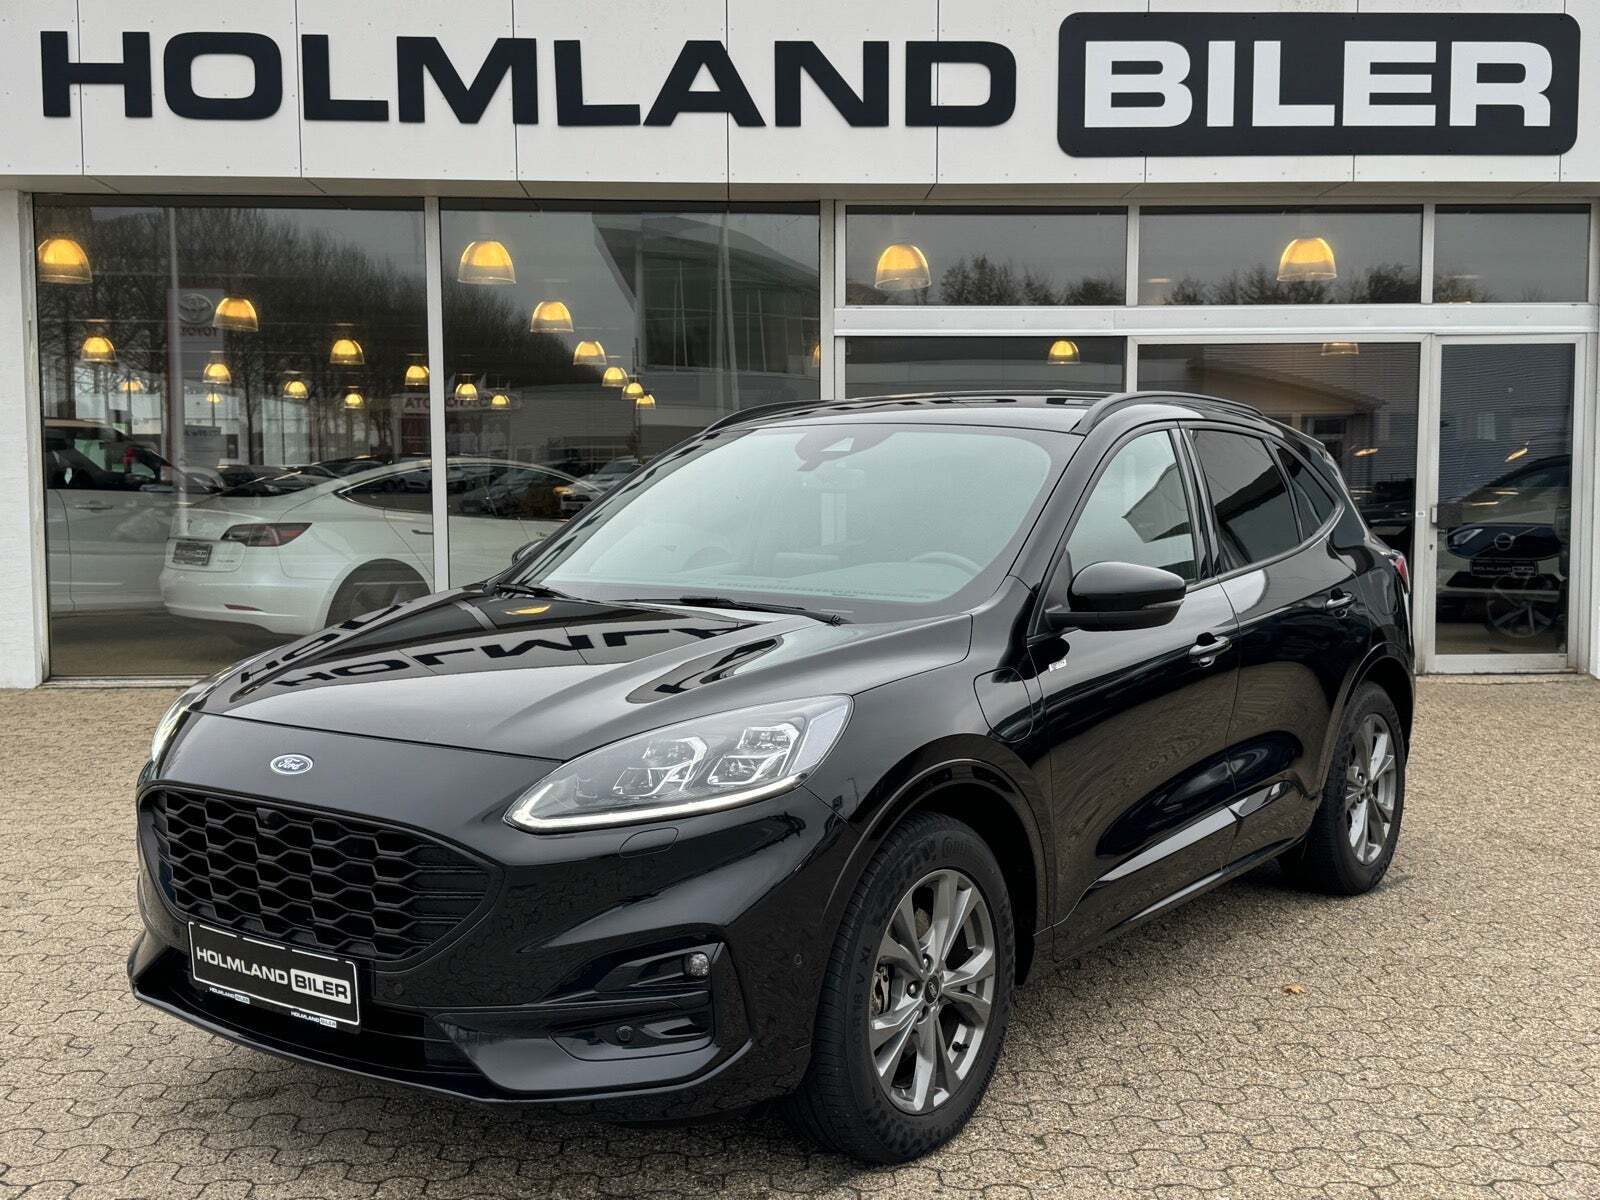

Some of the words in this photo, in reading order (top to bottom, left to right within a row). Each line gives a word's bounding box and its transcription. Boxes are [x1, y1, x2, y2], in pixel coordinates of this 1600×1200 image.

[40, 31, 1017, 128] HOLMLAND
[1084, 41, 1553, 128] BILER
[277, 757, 305, 771] Ford
[196, 946, 289, 985] HOLMLAND
[294, 974, 349, 1000] BILER
[209, 986, 236, 999] HOLMLAND
[291, 1010, 320, 1023] HOLMLAND
[320, 1017, 337, 1028] BILER
